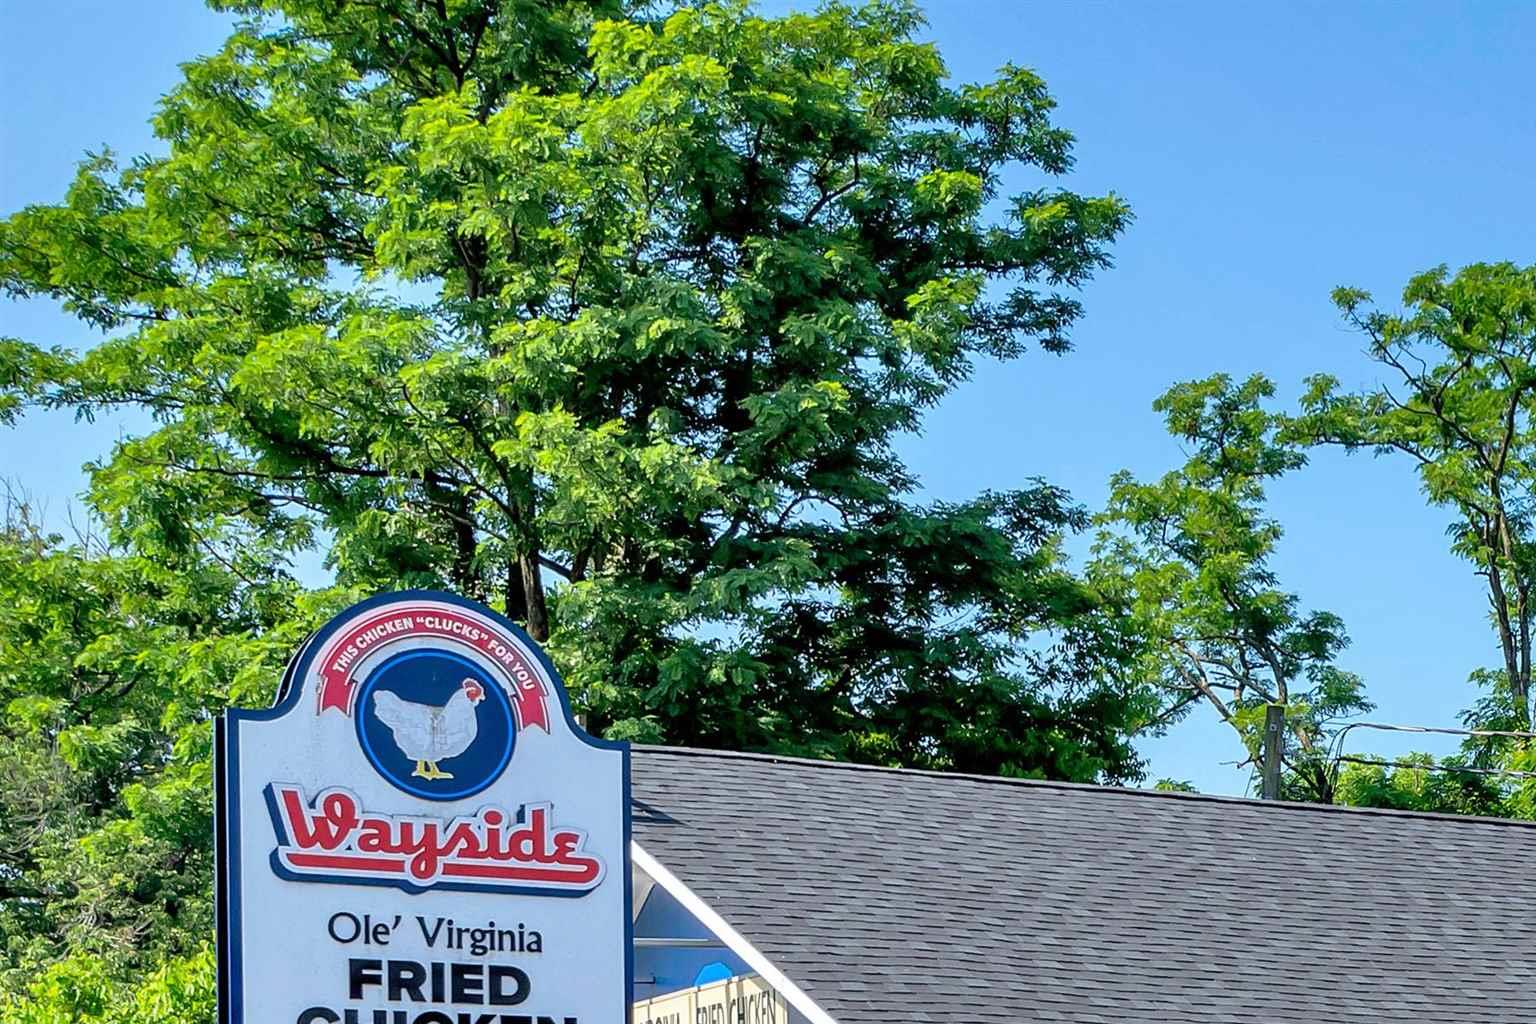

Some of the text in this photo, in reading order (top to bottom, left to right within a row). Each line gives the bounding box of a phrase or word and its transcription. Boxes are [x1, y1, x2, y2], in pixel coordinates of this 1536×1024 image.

[332, 645, 359, 673] THIS
[355, 617, 414, 649] CHICKEN
[487, 640, 514, 665] FOR
[512, 662, 535, 690] YOU
[281, 788, 586, 881] Wayside
[416, 915, 543, 956] Virginia
[348, 957, 531, 1006] FRIED
